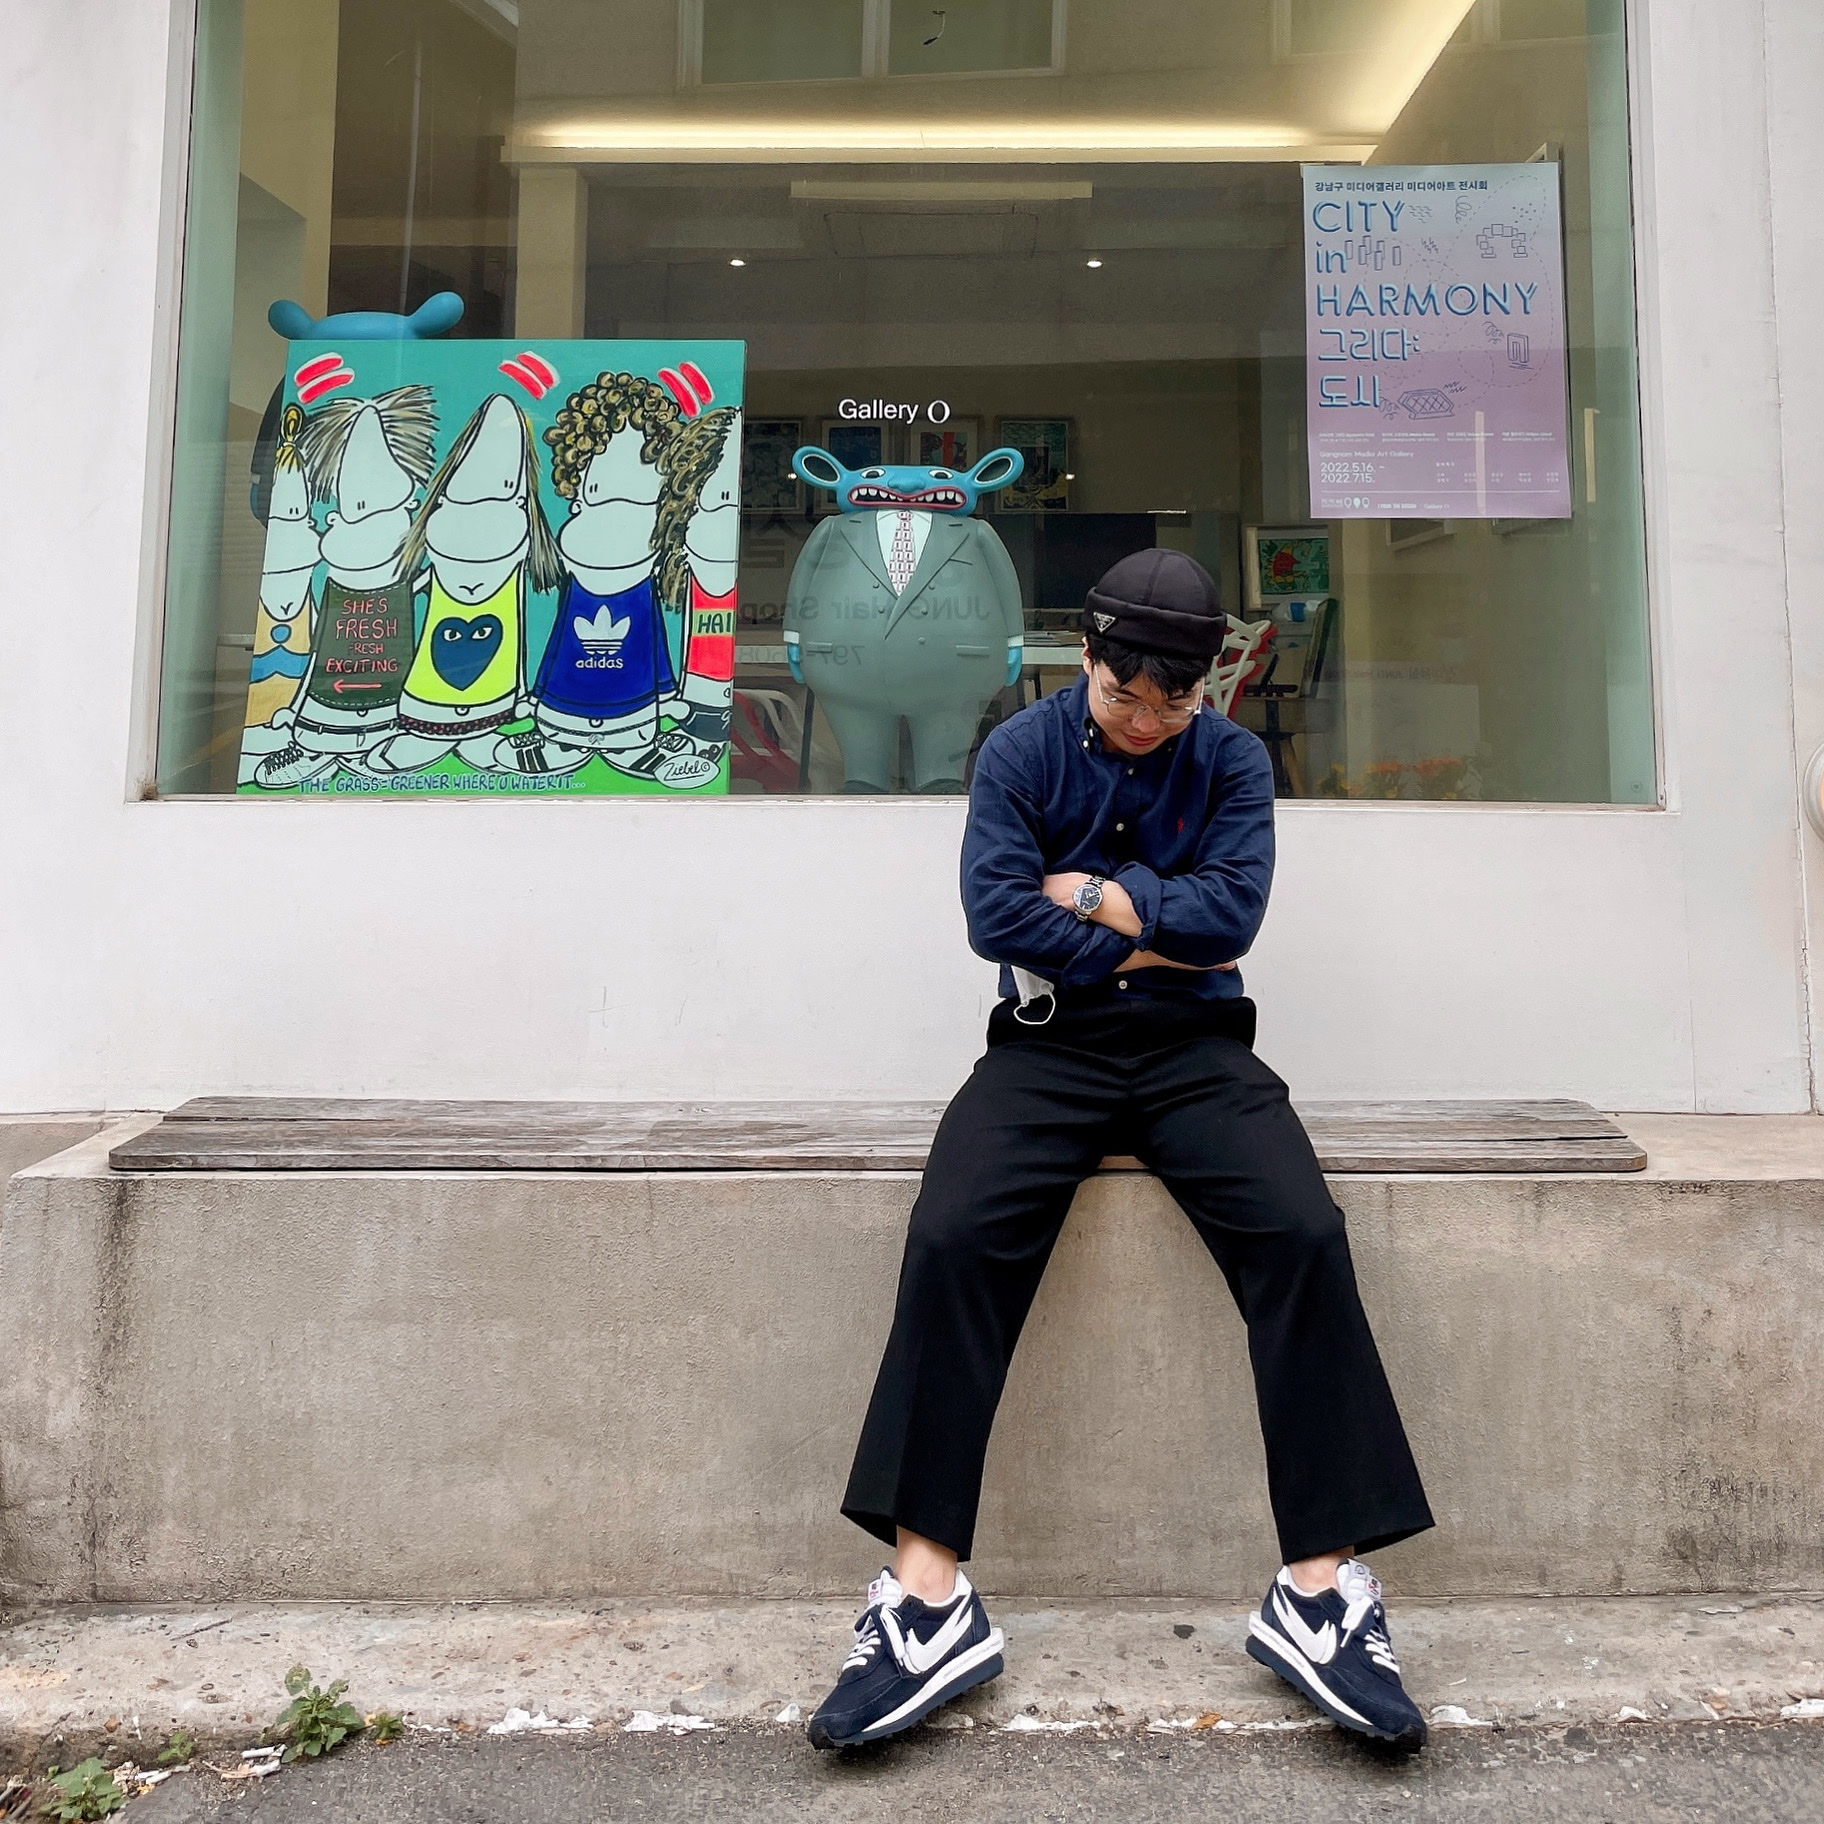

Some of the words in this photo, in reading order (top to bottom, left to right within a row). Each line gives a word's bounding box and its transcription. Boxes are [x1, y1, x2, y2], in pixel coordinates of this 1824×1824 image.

[1315, 181, 1344, 192] 강남구
[1346, 181, 1404, 192] 미디어갤러리
[1407, 181, 1456, 192] 미디어아트
[1458, 180, 1488, 191] 전시회
[1312, 200, 1405, 232] CITY
[1316, 241, 1347, 273] in
[1316, 282, 1538, 316] HARMONY
[1318, 375, 1381, 408] 도시
[838, 399, 919, 424] Gallery
[927, 400, 950, 424] O
[335, 618, 397, 640] FRESH
[325, 657, 398, 673] EXCITING
[575, 656, 624, 669] adidas
[299, 778, 331, 793] THE
[336, 775, 379, 792] GRASS
[391, 774, 450, 791] GREENER
[453, 774, 495, 790] WHERE
[499, 774, 508, 790] U
